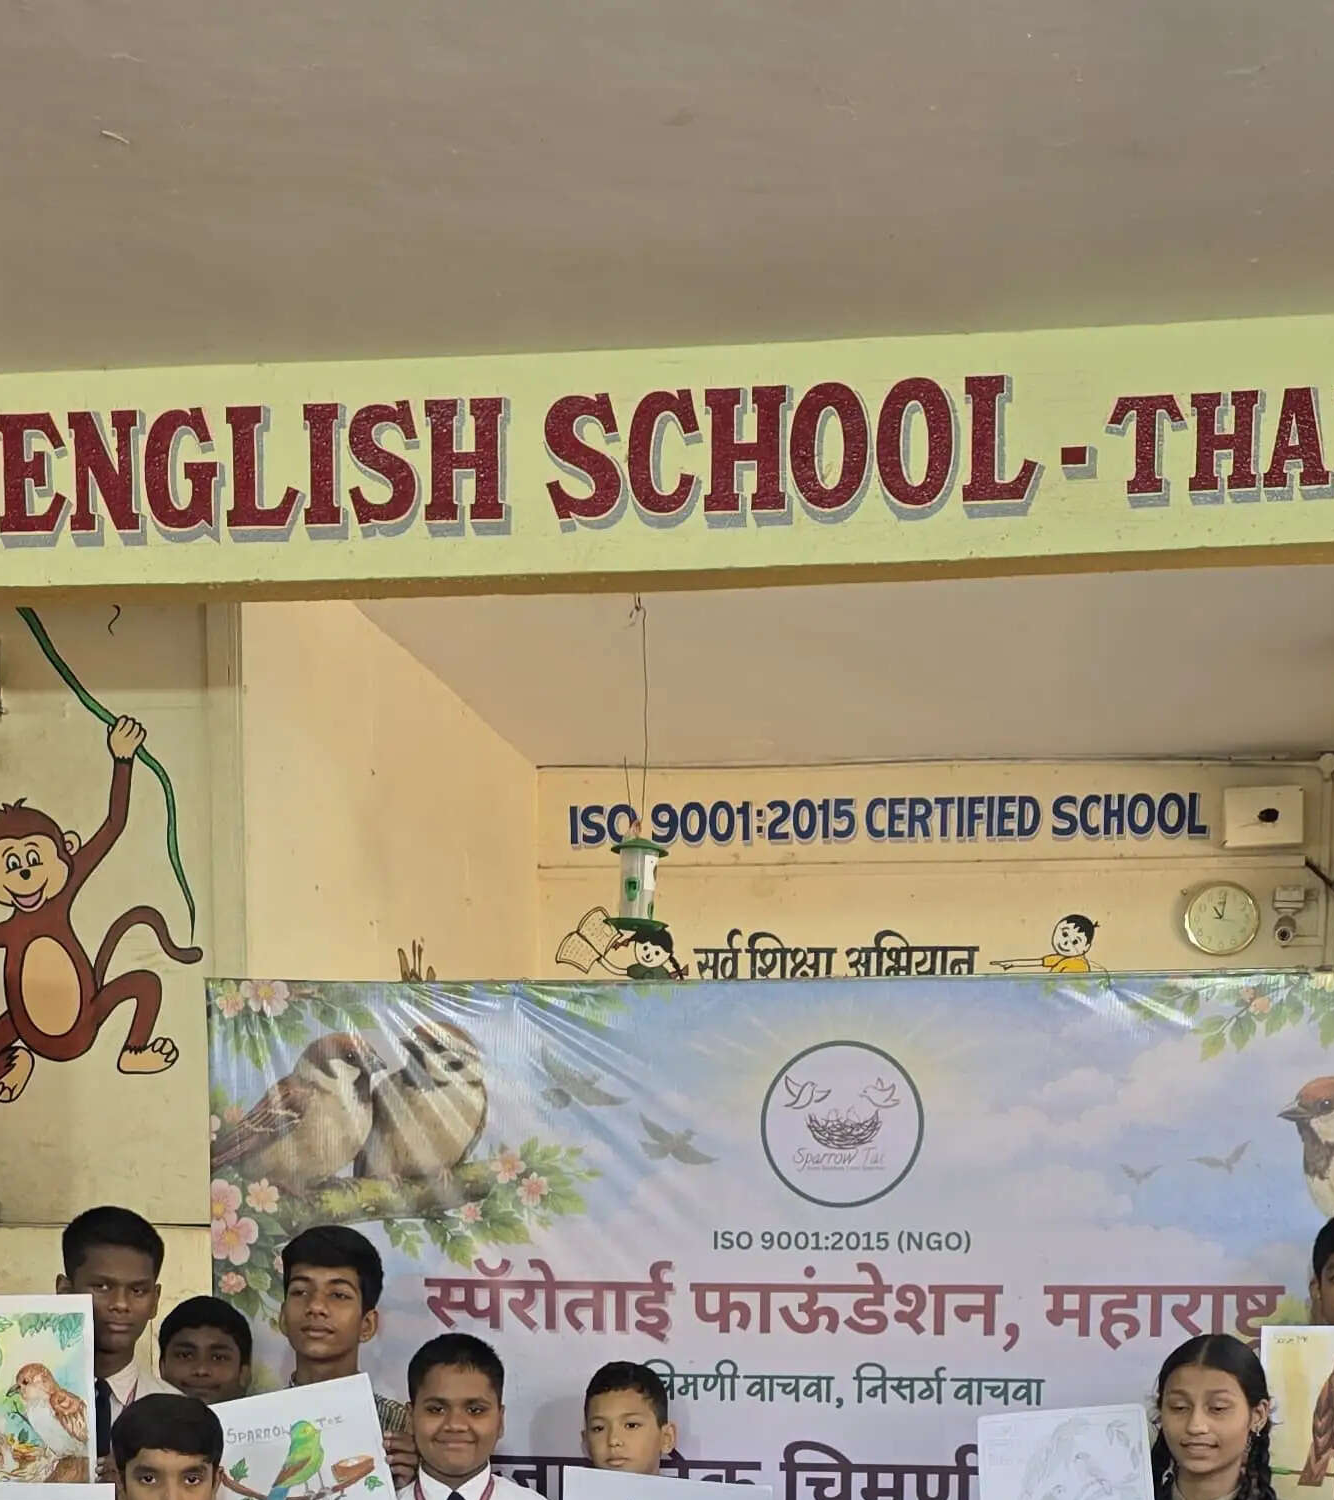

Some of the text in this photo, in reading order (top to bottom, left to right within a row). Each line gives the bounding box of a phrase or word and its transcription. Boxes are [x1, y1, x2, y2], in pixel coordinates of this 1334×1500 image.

[544, 374, 1041, 528] SCHOOL
[569, 792, 1210, 846] ISO 9001:2015 CERTIFIED SCHOOL
[693, 928, 979, 979] सर्व शिक्षा अभियान
[793, 1147, 858, 1172] Sparrow
[713, 1228, 972, 1254] ISO 9001:2015 (NGO)
[424, 1258, 674, 1342] स्पॅरोताई
[690, 1262, 1020, 1352] फाऊंडेशन,
[742, 1373, 844, 1408] वाचवा,
[853, 1361, 949, 1405] निसर्ग
[950, 1377, 1045, 1406] वाचवा
